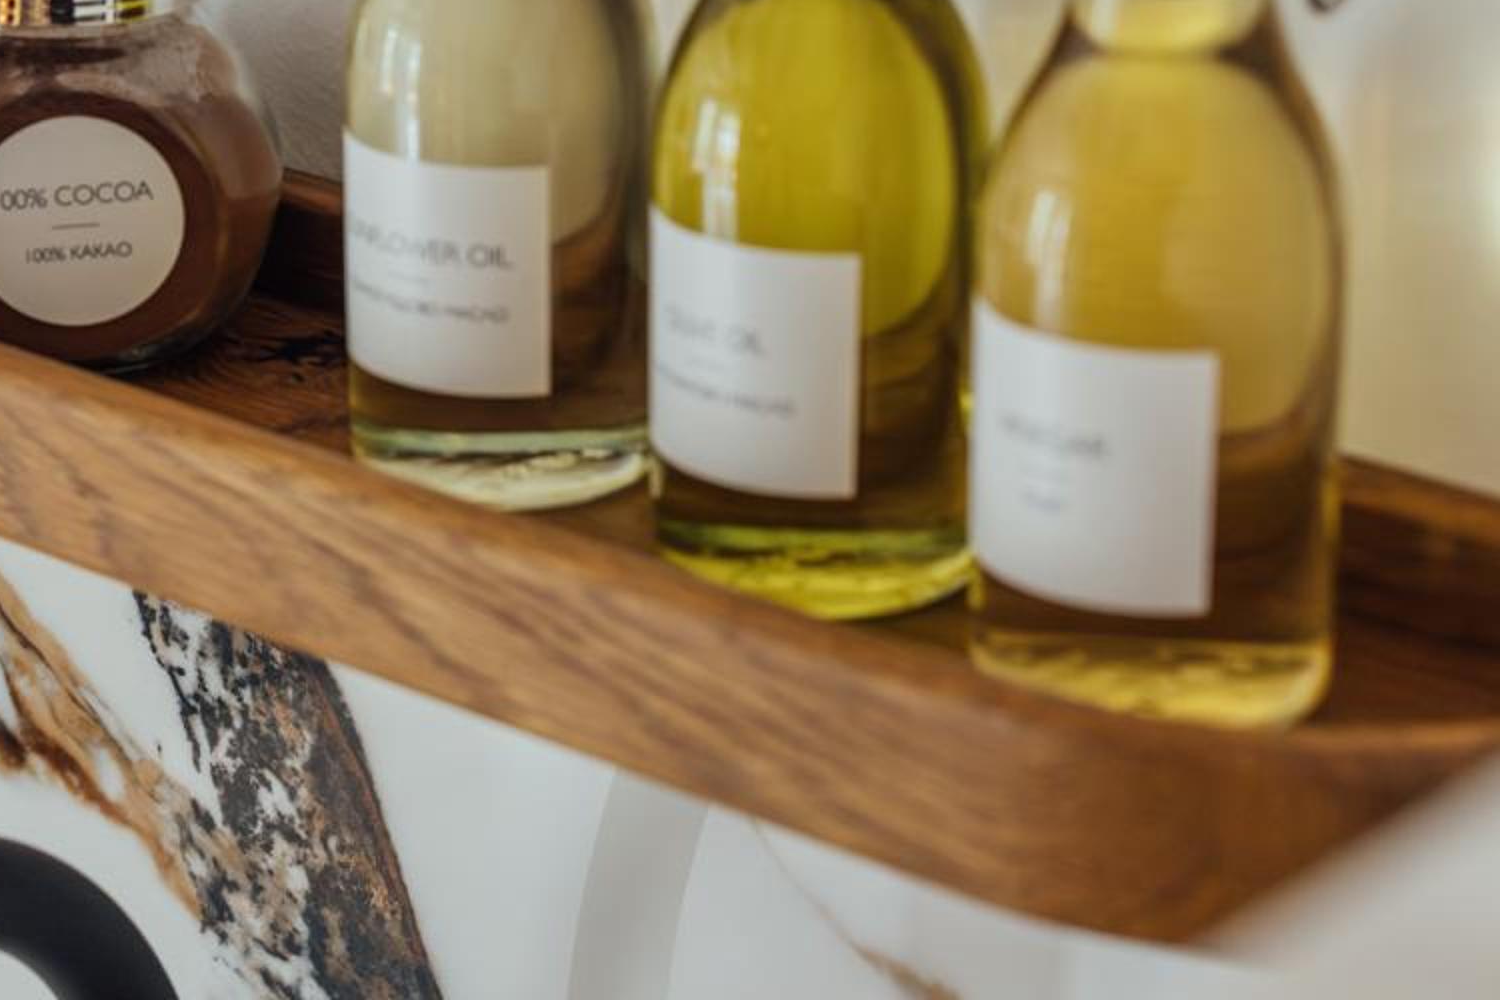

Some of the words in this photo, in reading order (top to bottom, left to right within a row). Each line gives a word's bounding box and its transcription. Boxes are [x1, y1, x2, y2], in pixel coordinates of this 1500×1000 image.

[53, 180, 155, 207] COCOA
[25, 245, 67, 265] 100%
[69, 240, 134, 261] КАКАО
